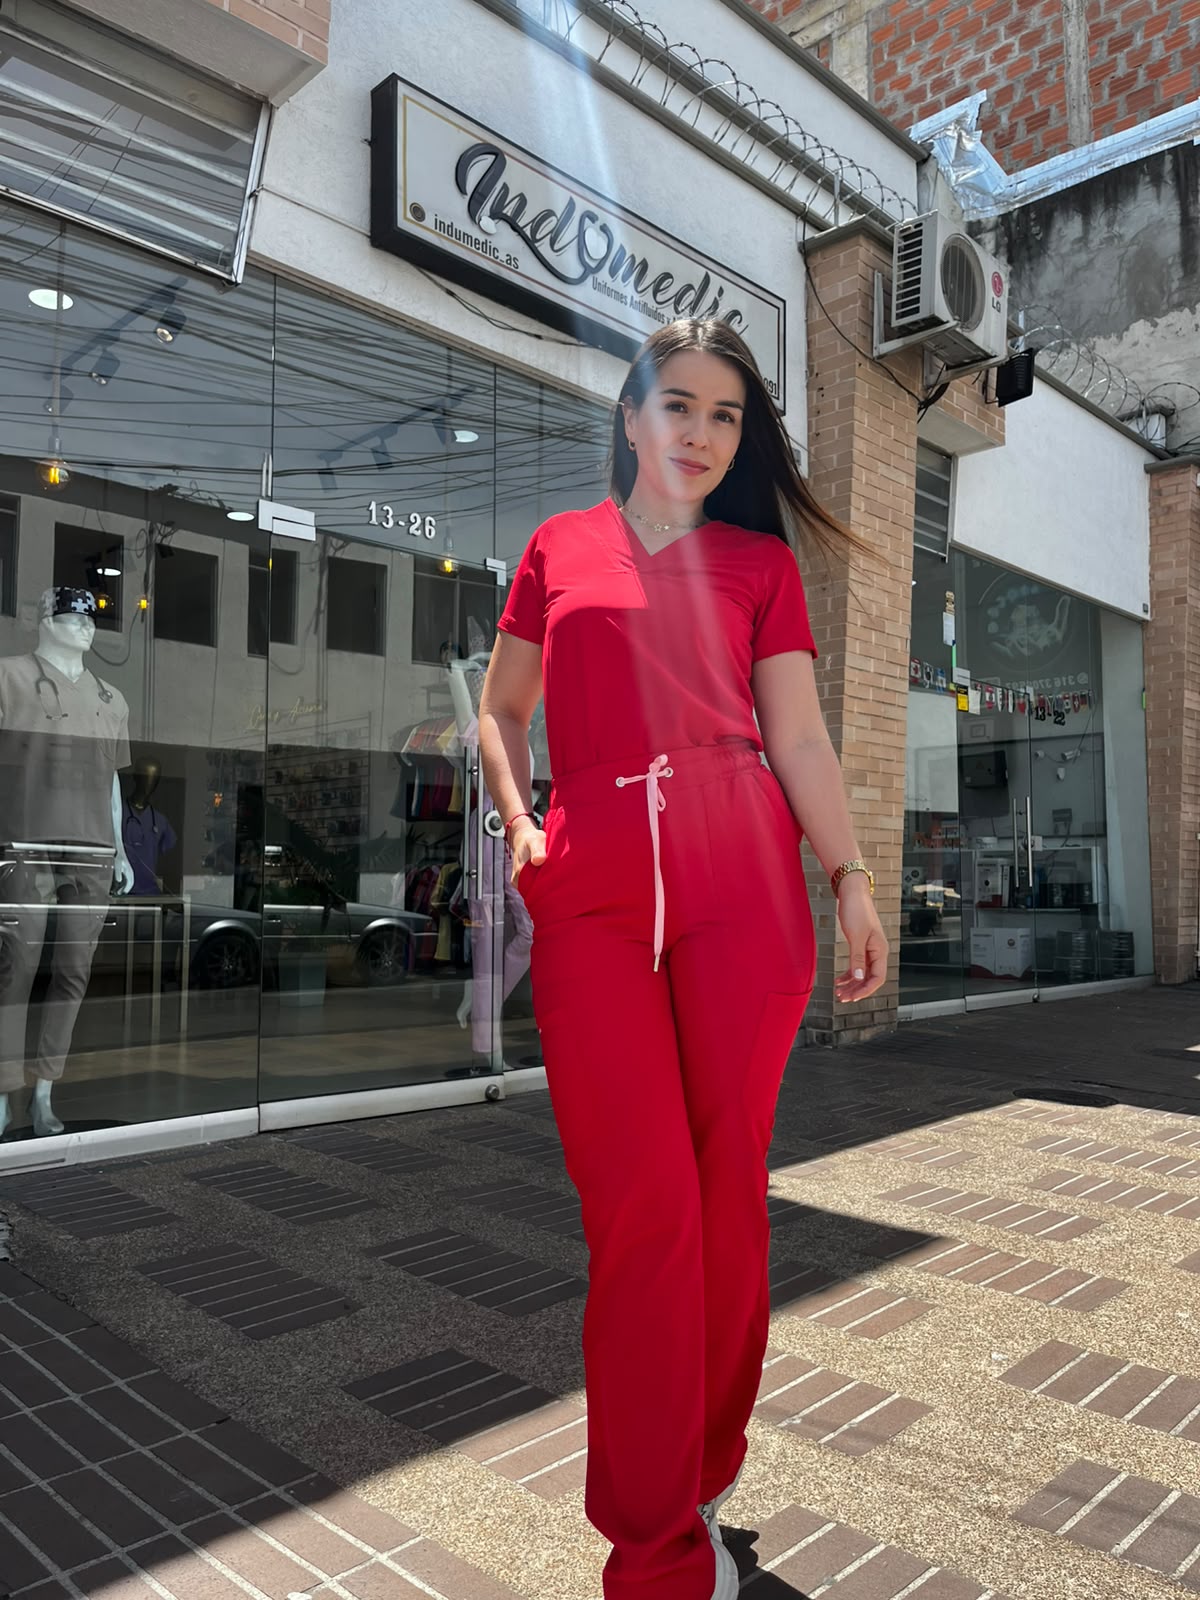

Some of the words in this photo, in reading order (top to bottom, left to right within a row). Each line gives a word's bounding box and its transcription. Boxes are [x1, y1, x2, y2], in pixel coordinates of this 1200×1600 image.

[434, 214, 519, 270] indumedic_as
[592, 276, 628, 306] Uniformes
[629, 296, 665, 324] Antifluidos
[992, 297, 1001, 313] LG
[368, 500, 436, 539] 13-26
[1034, 705, 1066, 726] 13-22
